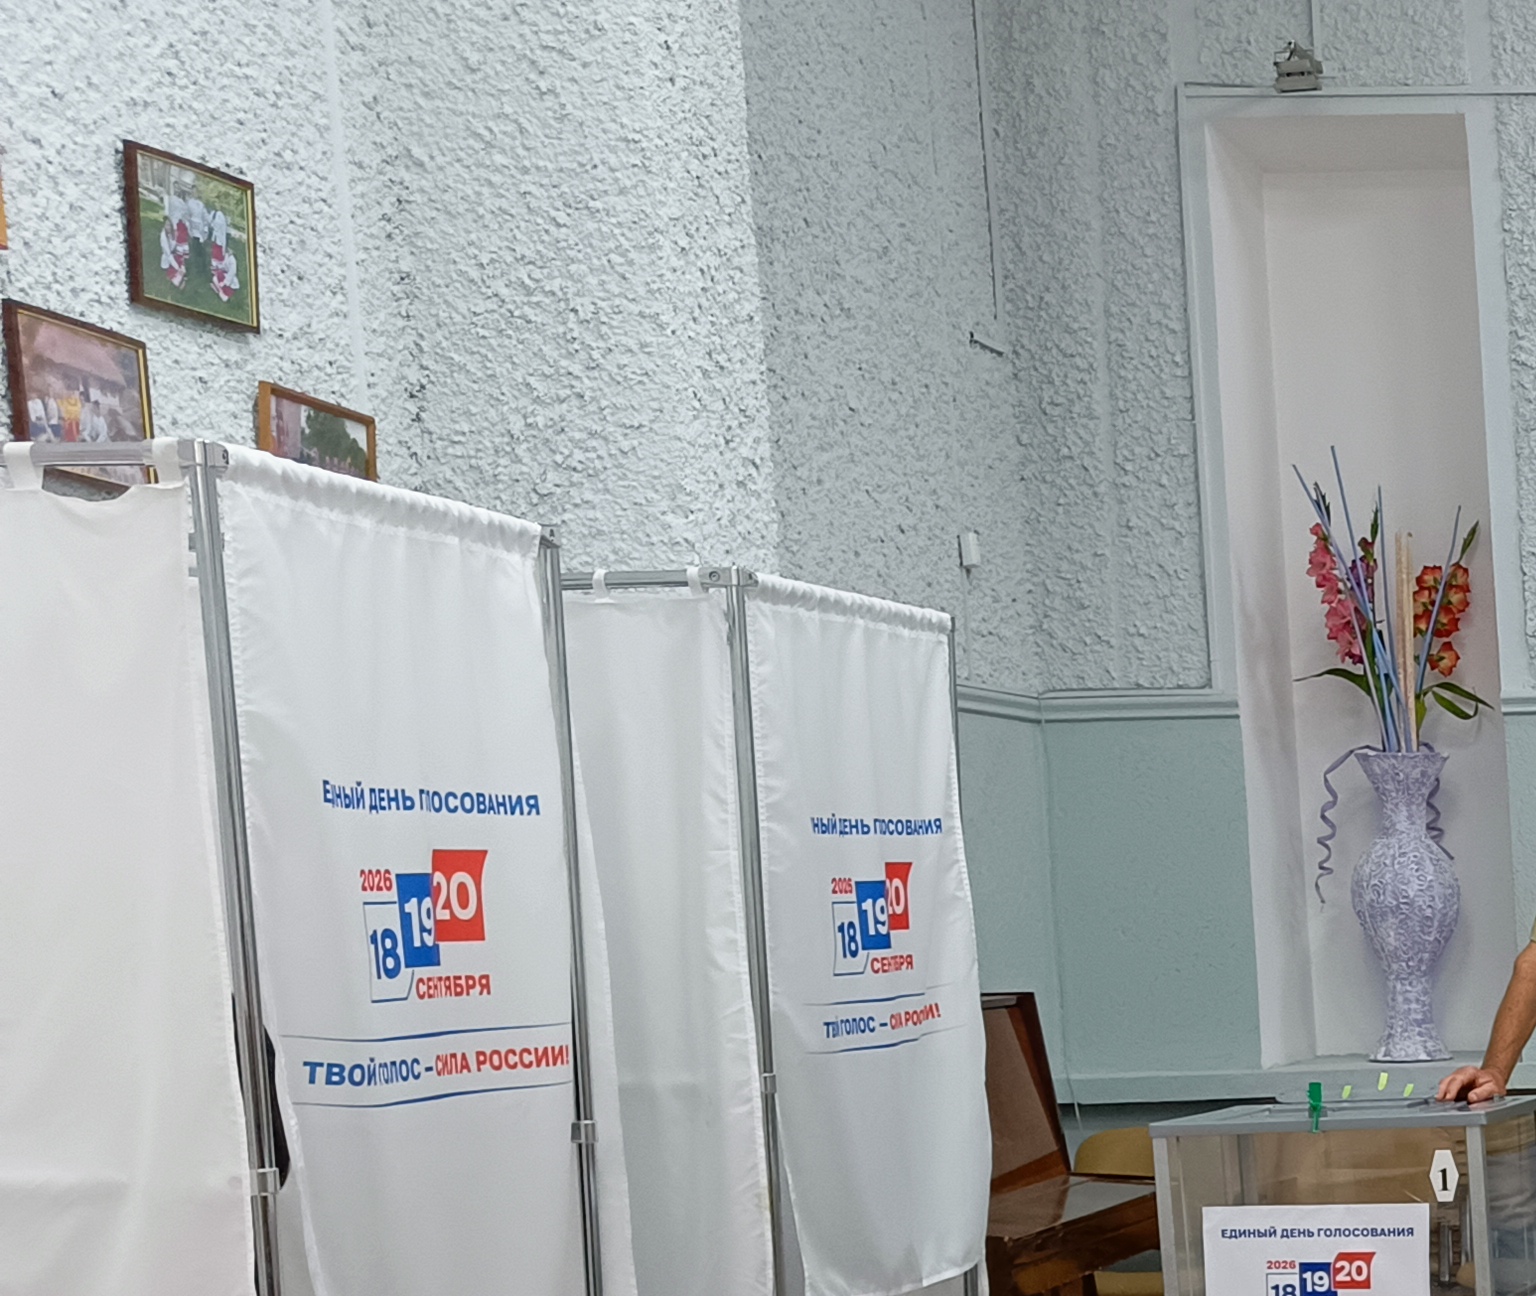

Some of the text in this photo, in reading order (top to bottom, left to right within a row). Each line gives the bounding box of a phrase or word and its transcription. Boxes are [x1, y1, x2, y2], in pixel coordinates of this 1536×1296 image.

[369, 787, 416, 814] ДЕНЬ
[839, 818, 871, 837] ДЕНЬ
[360, 869, 393, 892] 2026
[433, 871, 478, 920] 20
[404, 897, 435, 947] 19
[861, 897, 889, 936] 19
[370, 928, 402, 980] 18
[837, 921, 859, 959] 18
[415, 974, 492, 1000] СЕНТЯБРЯ
[303, 1057, 377, 1087] ТВОЙ
[435, 1054, 472, 1077] СИЛА
[475, 1044, 570, 1072] РОССИИ!
[1437, 1167, 1451, 1192] 1
[1221, 1226, 1414, 1240] ЕДИНЫЙ ДЕНЬ ГОЛОСОВАНИЯ
[1266, 1260, 1297, 1270] 2026
[1302, 1270, 1330, 1293] 19
[1335, 1260, 1368, 1282] 20
